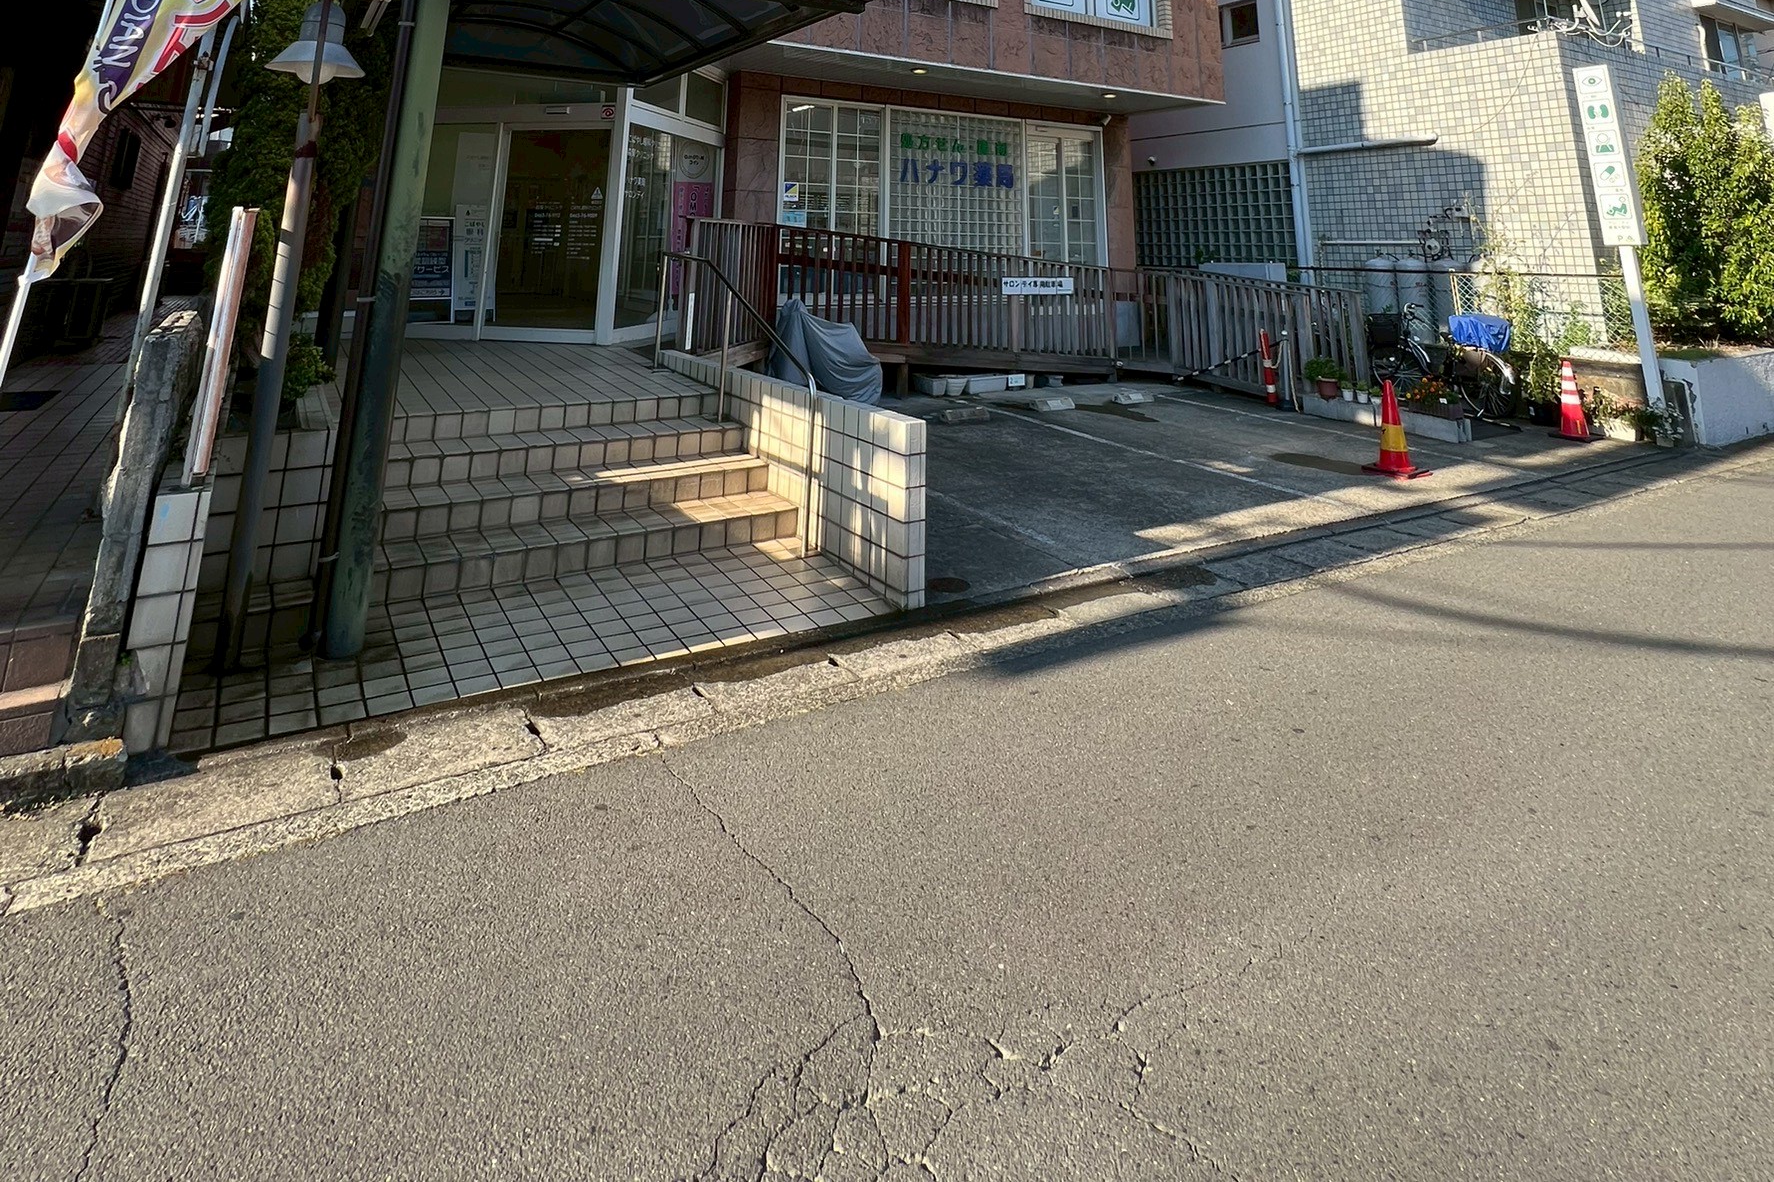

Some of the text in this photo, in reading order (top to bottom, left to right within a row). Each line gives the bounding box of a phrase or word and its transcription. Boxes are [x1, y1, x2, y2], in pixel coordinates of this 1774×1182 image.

[900, 158, 1014, 189] ハナワ薬局
